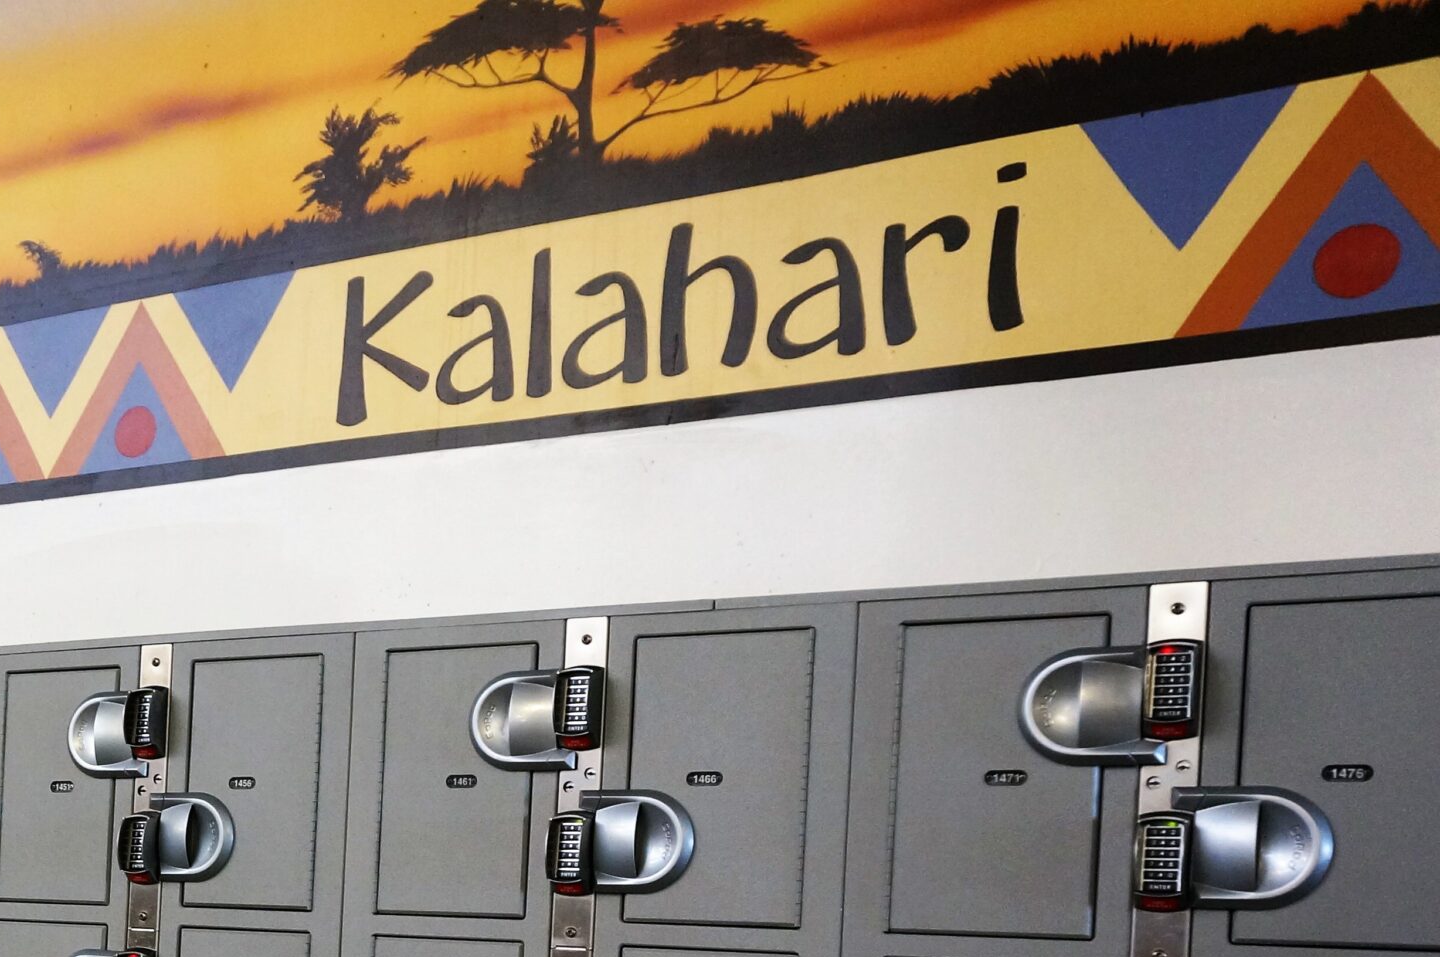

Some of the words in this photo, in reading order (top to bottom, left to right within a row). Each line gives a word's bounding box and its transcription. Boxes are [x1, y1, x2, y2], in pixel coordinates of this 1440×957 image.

[336, 162, 1027, 427] Kalahari
[993, 773, 1020, 783] 1471
[1331, 768, 1364, 779] 1476
[453, 777, 472, 786] 1461
[693, 774, 717, 784] 1466
